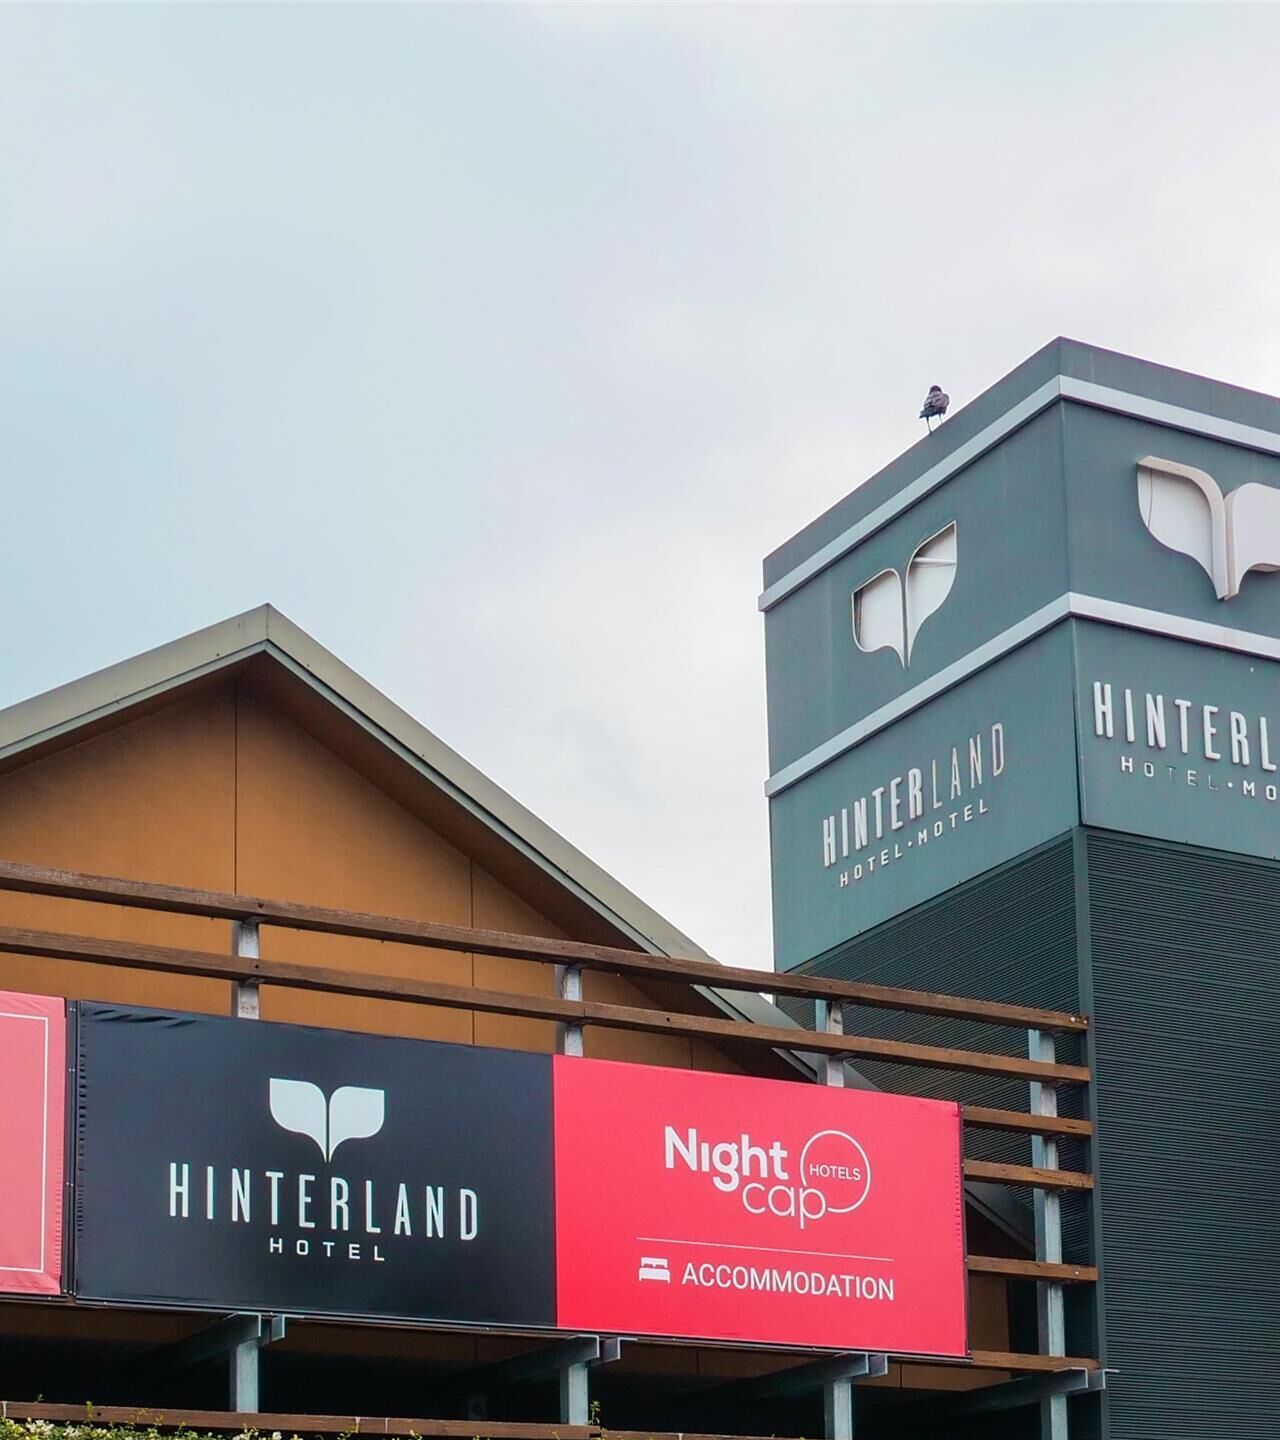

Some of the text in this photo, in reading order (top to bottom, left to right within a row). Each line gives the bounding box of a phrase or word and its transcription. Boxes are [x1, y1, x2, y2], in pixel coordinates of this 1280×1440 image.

[823, 723, 1005, 868] HINTERLAND
[664, 1126, 789, 1192] Night
[809, 1164, 861, 1181] HOTELS
[169, 1162, 478, 1241] HINTERLAND
[742, 1183, 827, 1230] cap
[270, 1238, 385, 1261] HOTEL
[682, 1262, 894, 1300] ACCOMMODATION
